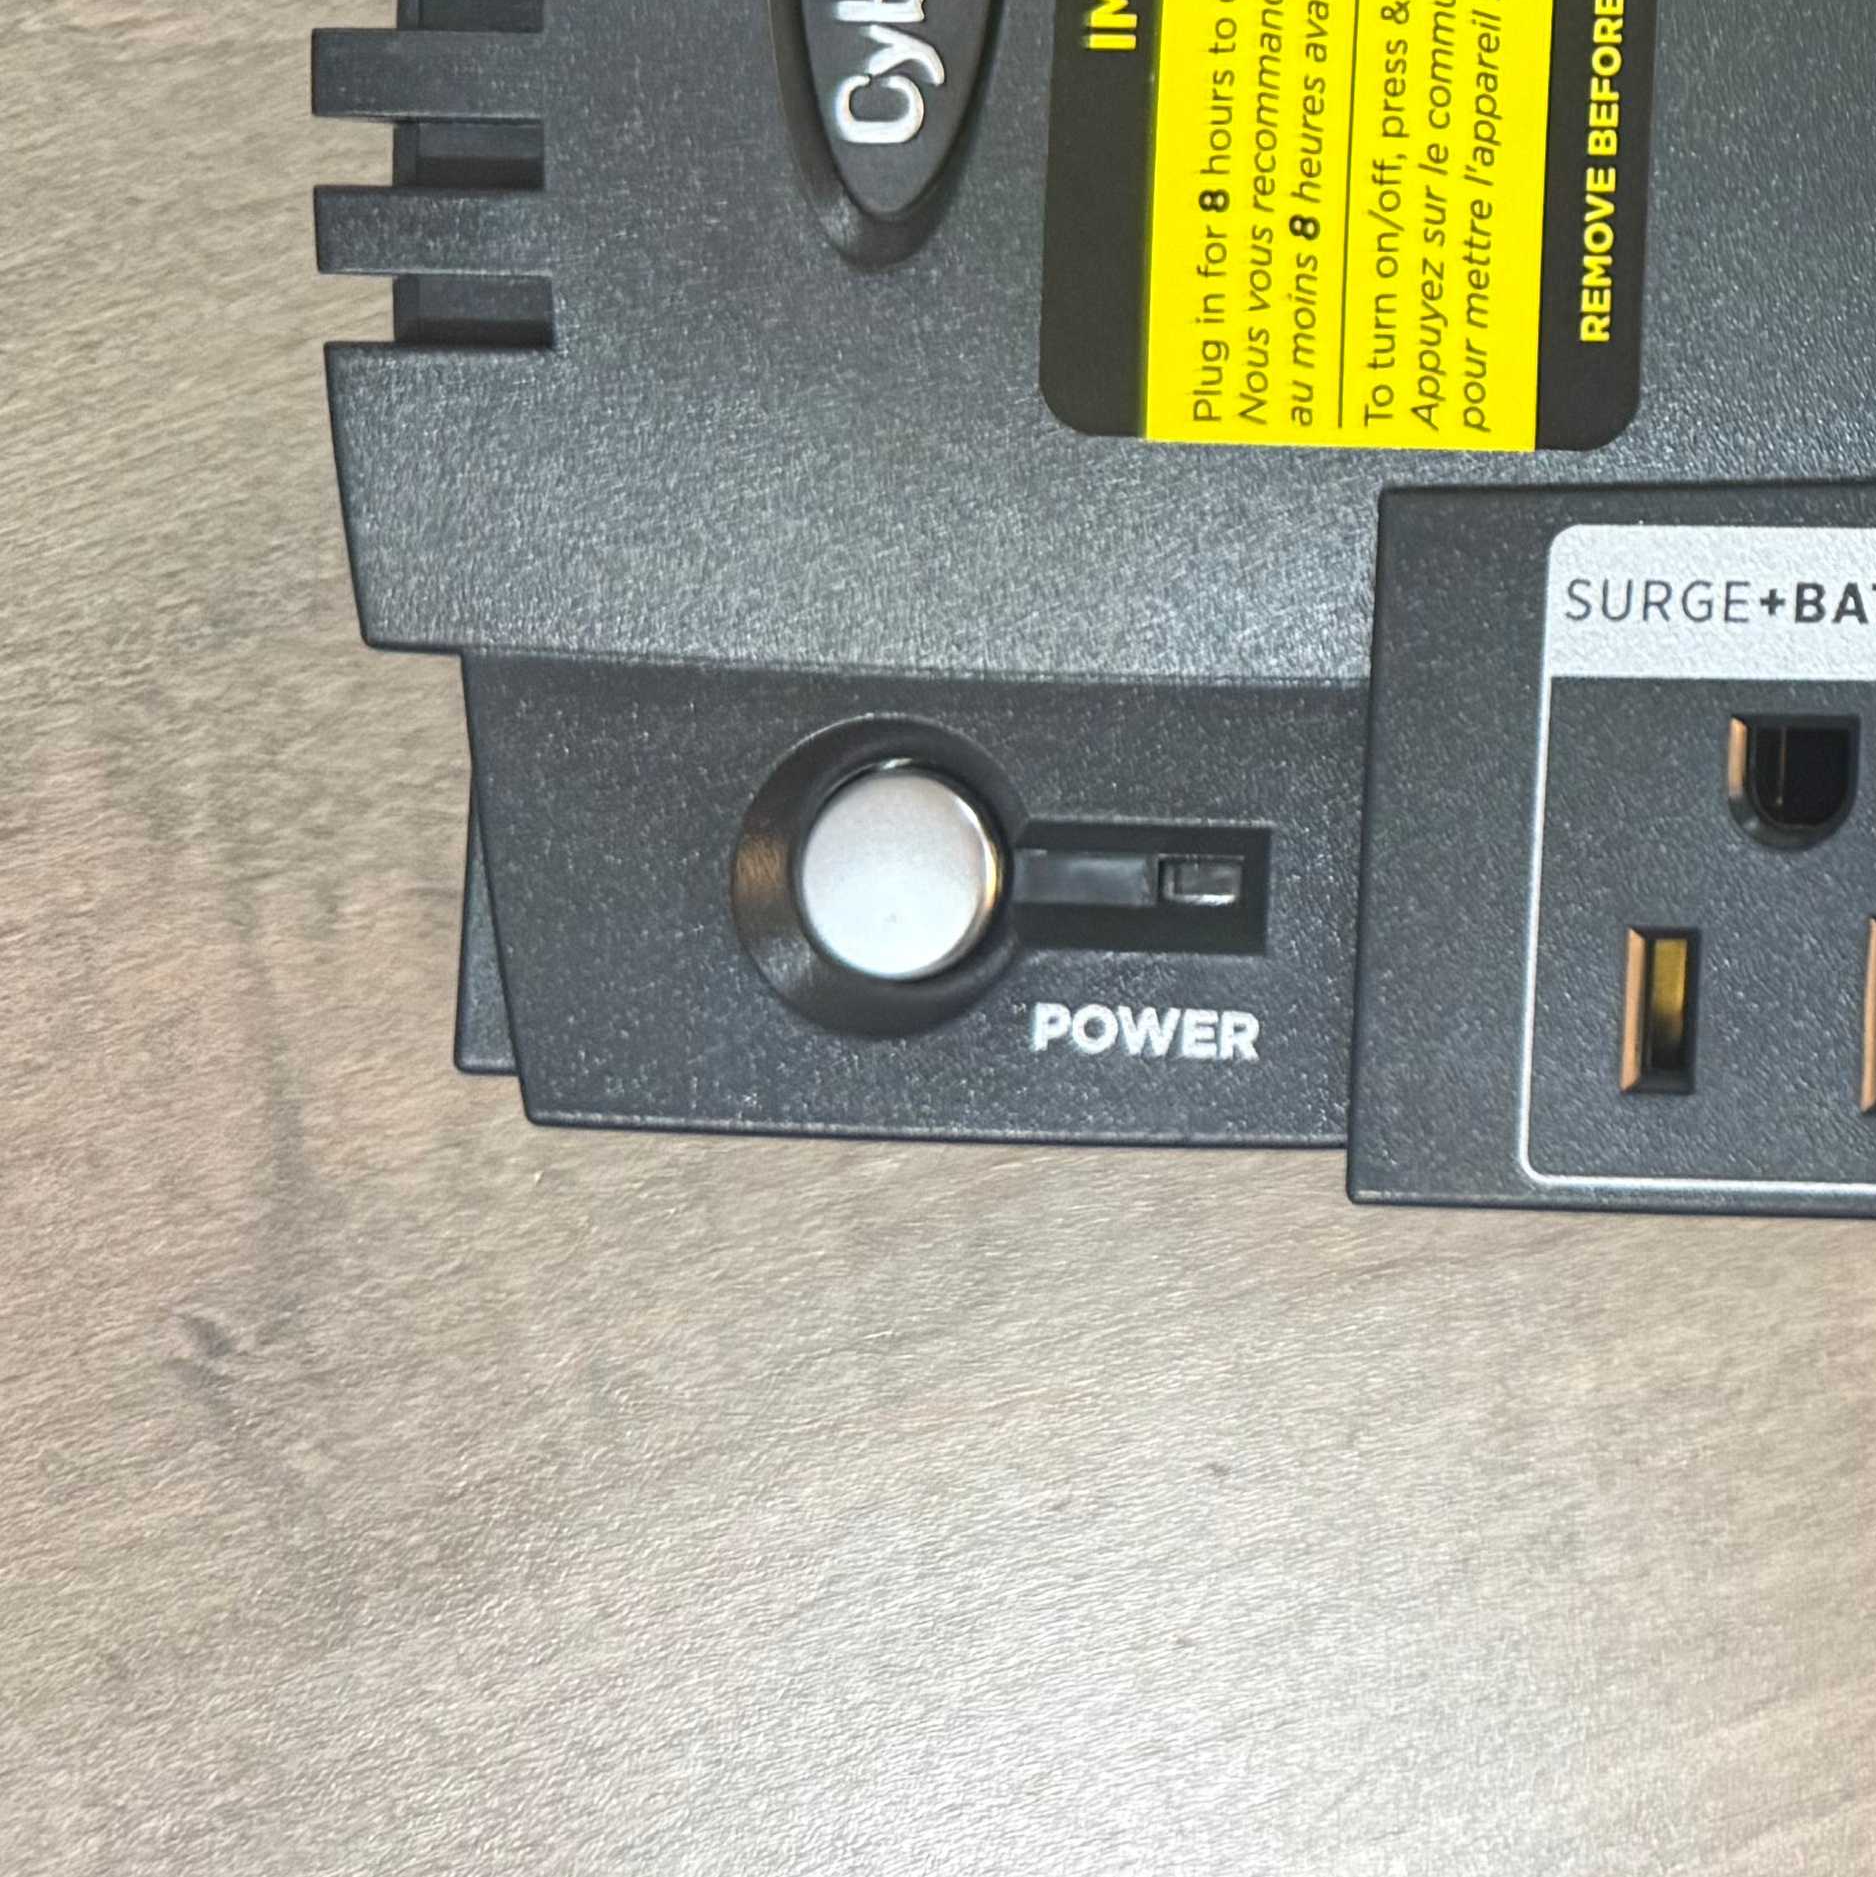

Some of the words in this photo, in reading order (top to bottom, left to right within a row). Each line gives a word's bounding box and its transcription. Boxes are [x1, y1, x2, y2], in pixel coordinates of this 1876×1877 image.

[1207, 17, 1238, 56] to
[1379, 0, 1411, 26] &
[1199, 69, 1236, 176] hours
[1381, 38, 1410, 139] press
[1463, 8, 1503, 187] l'appareil
[1290, 75, 1327, 204] heures
[1417, 142, 1450, 176] le
[1197, 188, 1231, 214] 8
[1287, 213, 1322, 242] 8
[1368, 153, 1407, 280] on/off,
[1422, 184, 1447, 248] sur
[1195, 224, 1228, 279] for
[1247, 225, 1274, 313] vous
[1462, 198, 1494, 329] mettre
[1578, 165, 1618, 343] REMOVE
[1195, 293, 1225, 324] in
[1292, 252, 1319, 369] moins
[1366, 293, 1397, 371] turn
[1409, 257, 1449, 431] Appuyez
[1192, 339, 1230, 422] Plug
[1237, 326, 1270, 425] Nous
[1290, 380, 1314, 427] au
[1363, 383, 1395, 428] To
[1462, 337, 1491, 433] pour
[1031, 1003, 1259, 1060] POWER
